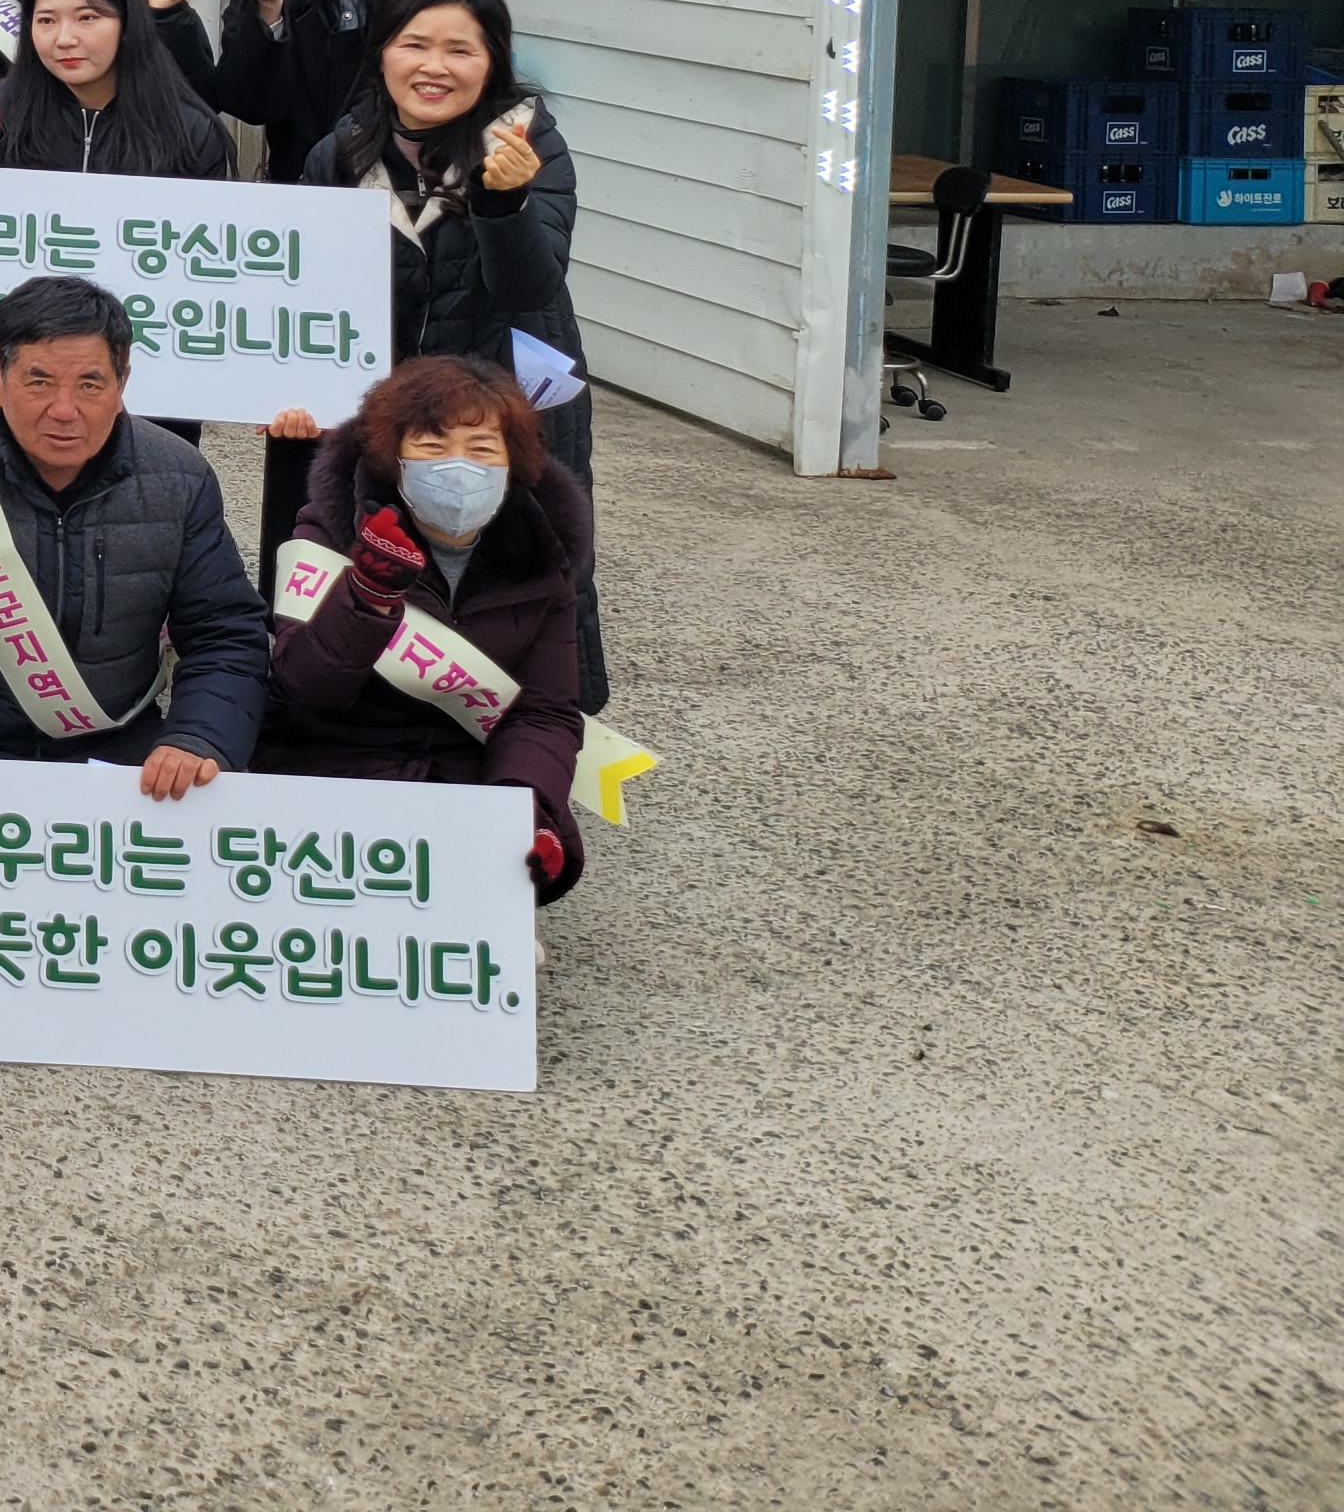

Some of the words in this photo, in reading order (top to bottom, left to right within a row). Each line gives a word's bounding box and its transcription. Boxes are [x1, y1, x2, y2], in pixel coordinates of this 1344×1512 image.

[1236, 53, 1264, 69] Cass
[1109, 126, 1136, 141] Cass
[1227, 123, 1267, 146] Cass
[1106, 194, 1133, 210] Cass
[1234, 192, 1283, 205] 하이트진로
[122, 217, 302, 283] 당신의
[217, 826, 431, 904] 당신의
[131, 921, 521, 1008] 이웃입니다.
